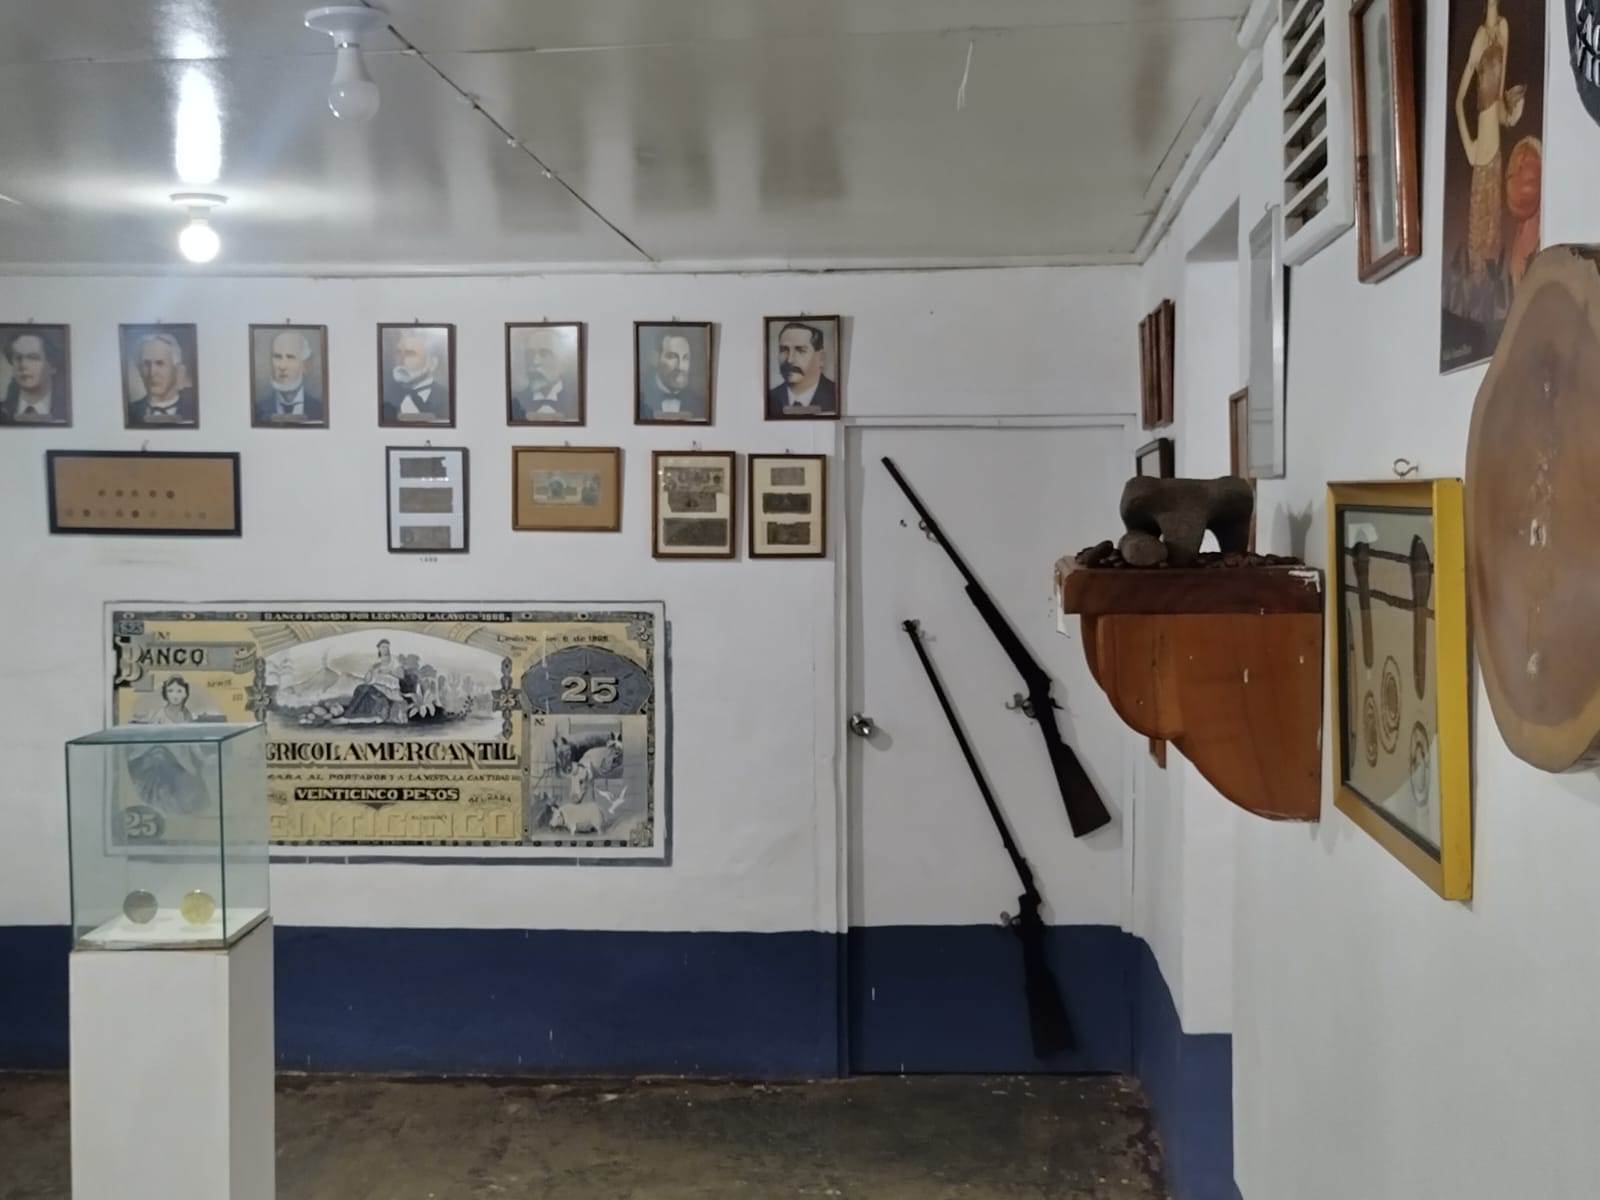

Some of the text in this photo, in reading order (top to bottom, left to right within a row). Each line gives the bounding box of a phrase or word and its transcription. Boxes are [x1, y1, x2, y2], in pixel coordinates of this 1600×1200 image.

[304, 612, 348, 621] FUNDADO
[349, 612, 369, 621] POR
[371, 612, 425, 621] LEONARDO
[426, 612, 465, 621] LACAYO
[113, 636, 205, 684] BANCO
[500, 693, 517, 706] 25
[560, 675, 621, 704] 25
[264, 742, 517, 761] GRICOLA MERCANTIL
[296, 788, 398, 800] VEINTICINCO
[402, 788, 459, 800] PESOS
[125, 811, 158, 837] 25
[269, 811, 517, 838] EINTICINCO
